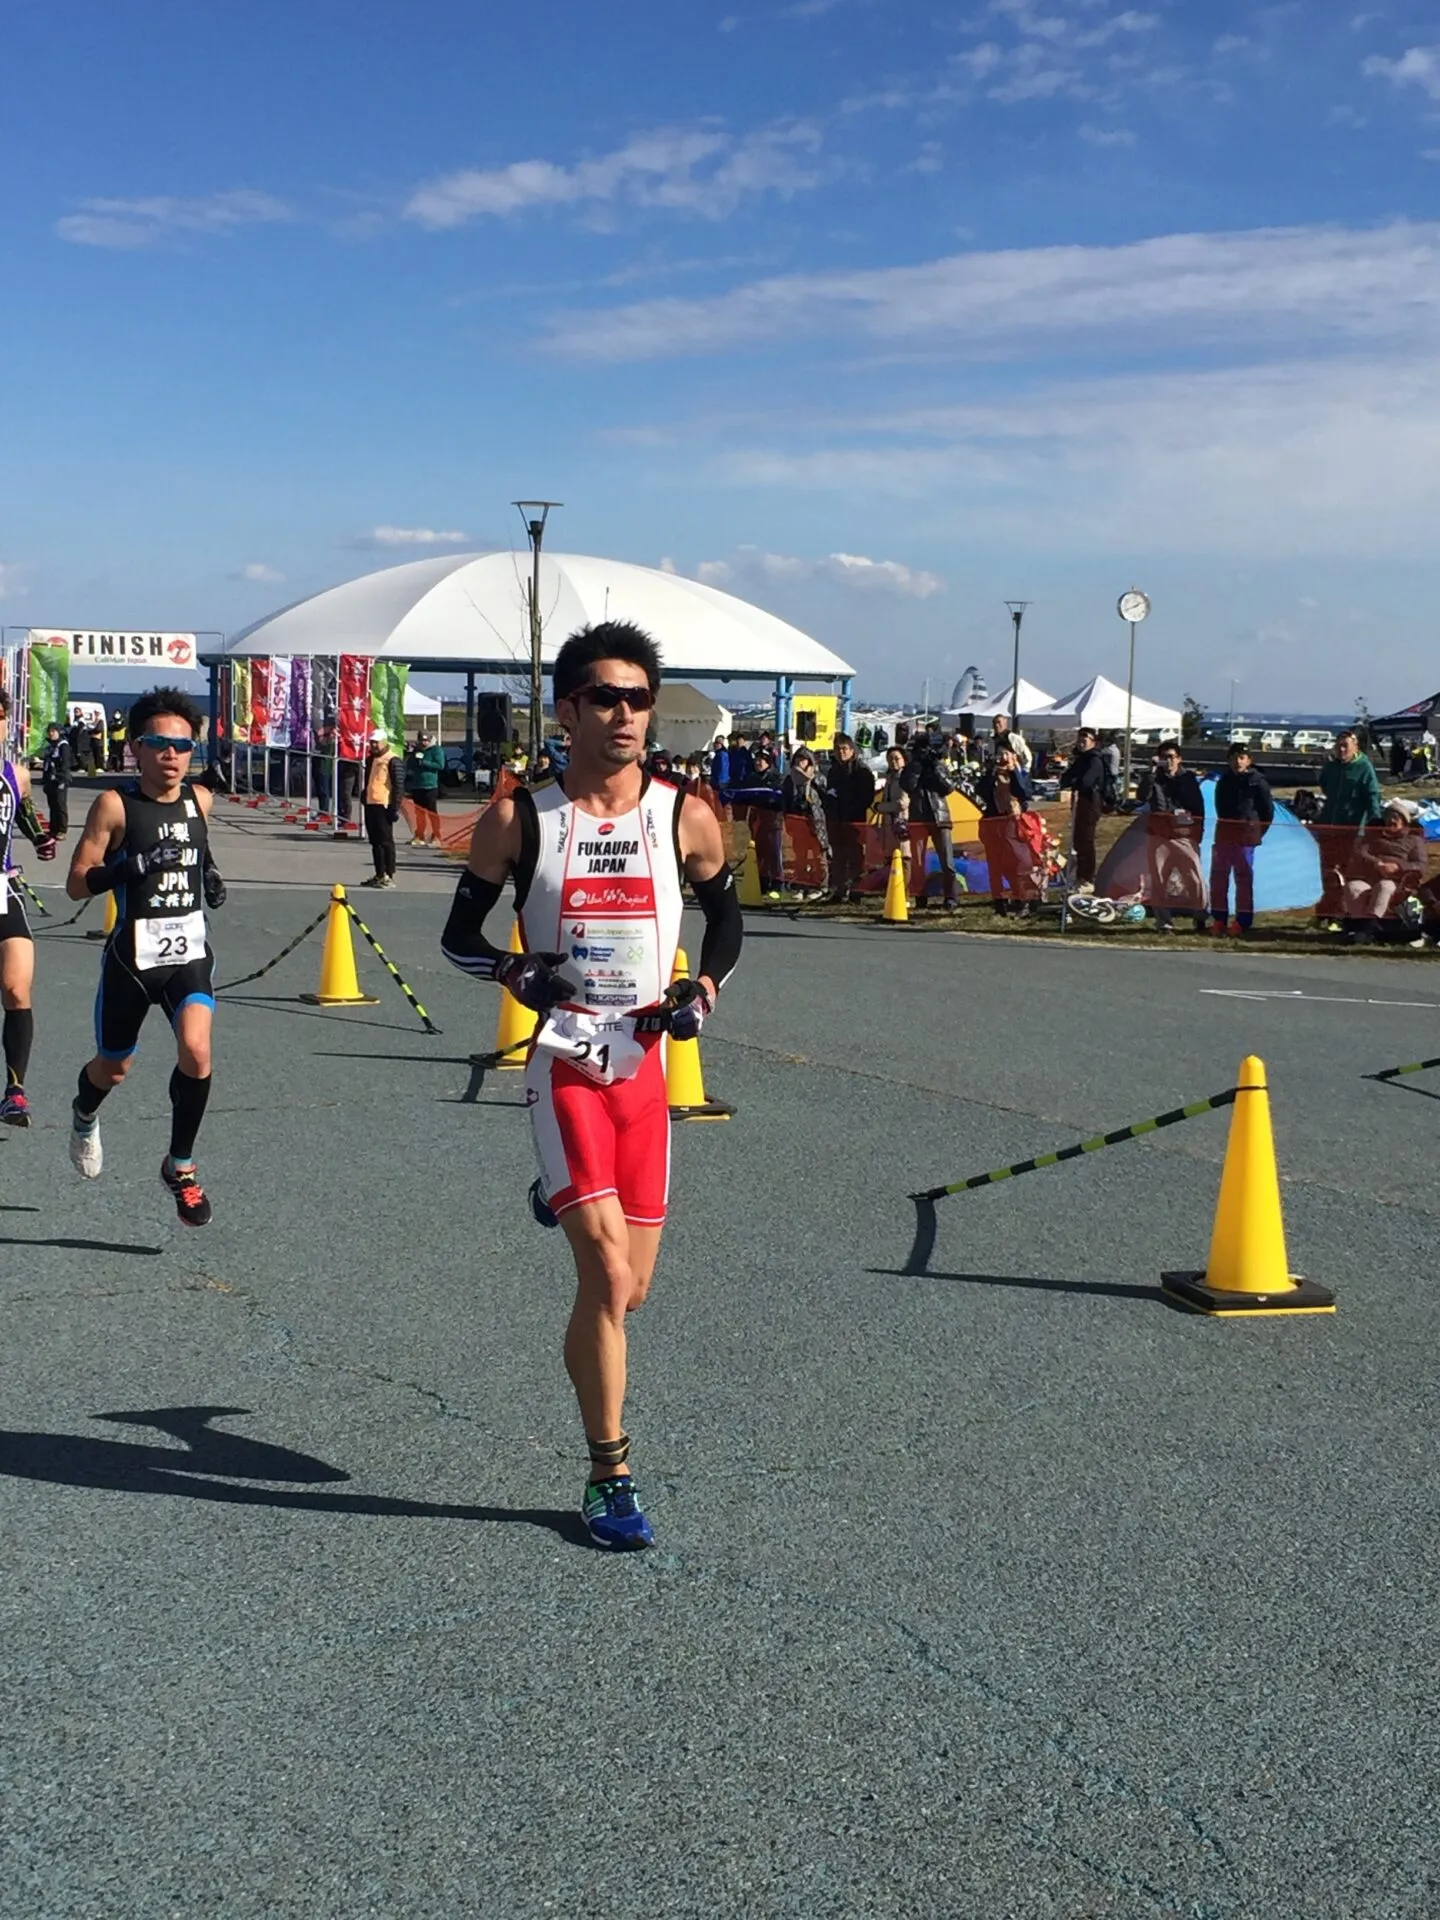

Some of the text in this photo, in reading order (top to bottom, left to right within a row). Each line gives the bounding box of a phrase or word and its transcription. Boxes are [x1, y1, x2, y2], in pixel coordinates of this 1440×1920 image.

[73, 634, 163, 656] FINISH
[271, 672, 287, 731] ASSIST
[578, 840, 639, 856] FUKAURA
[587, 858, 627, 873] JAPAN
[158, 871, 190, 891] JPN
[158, 936, 188, 957] 23
[569, 1041, 610, 1073] 21
